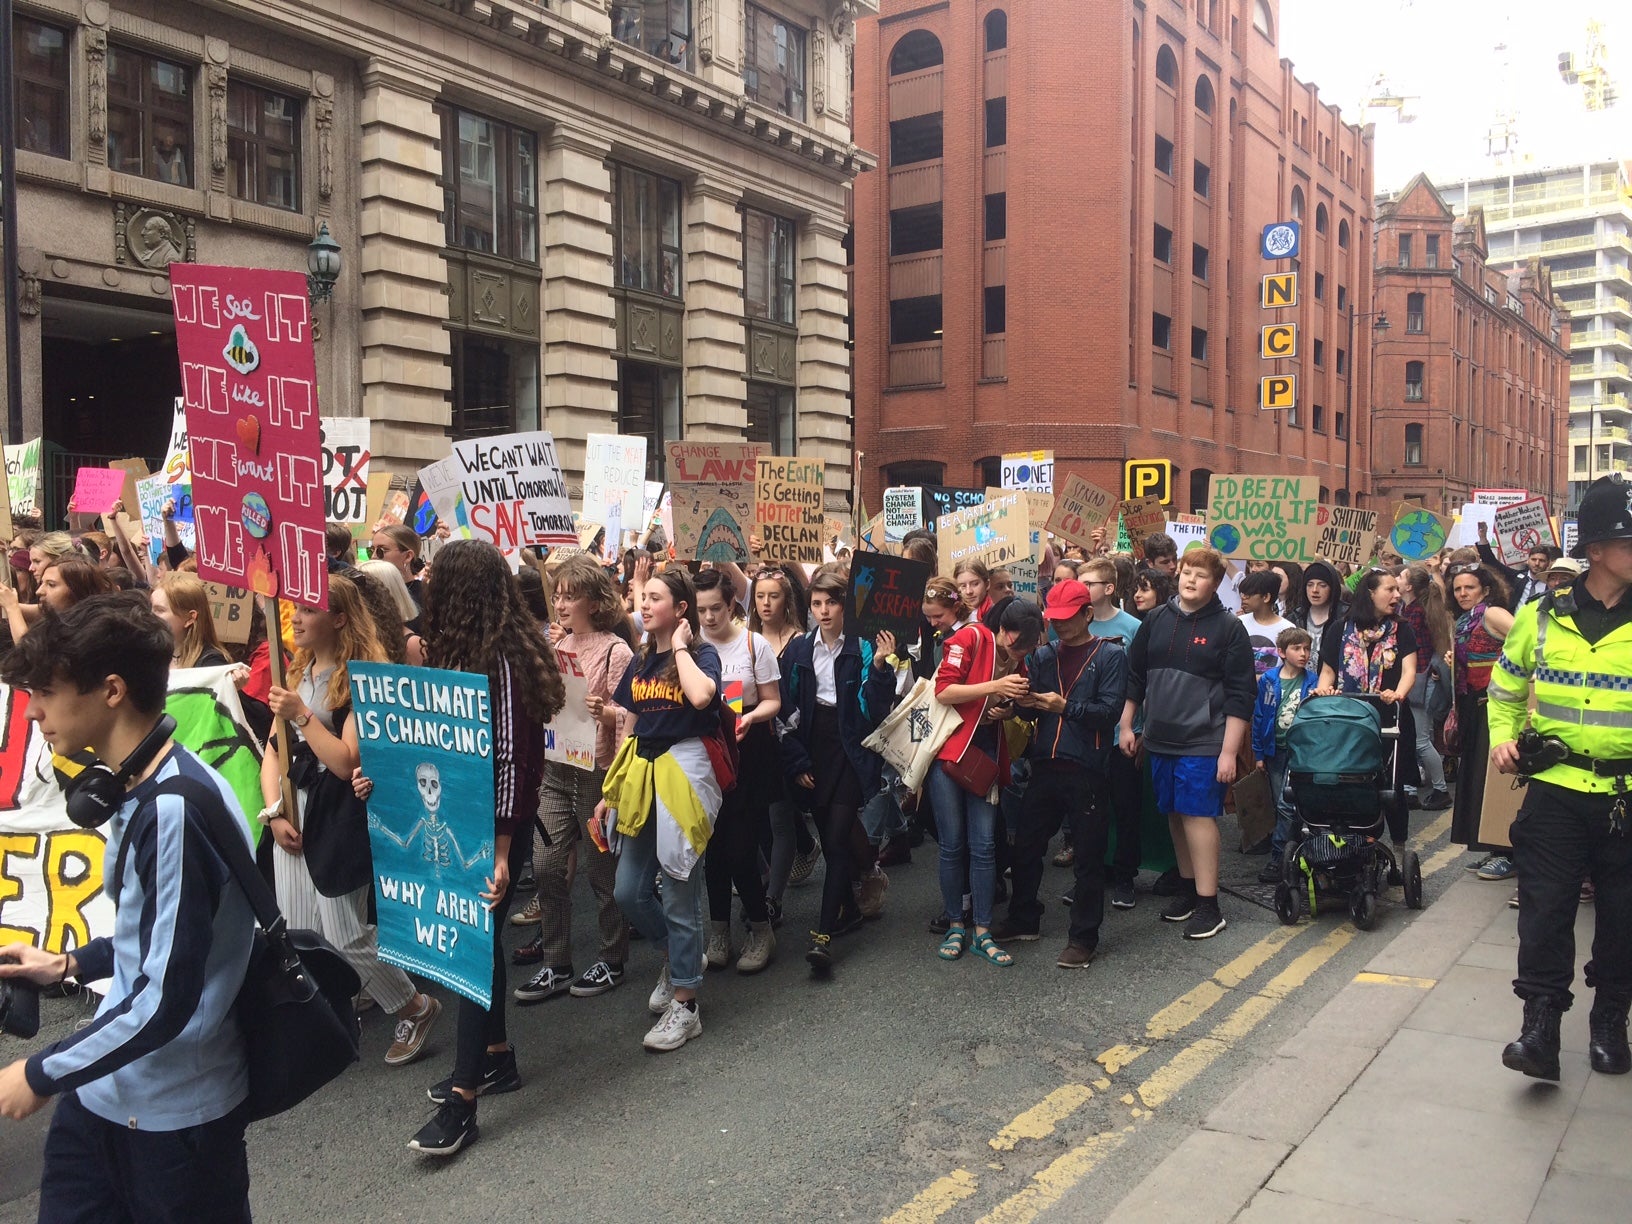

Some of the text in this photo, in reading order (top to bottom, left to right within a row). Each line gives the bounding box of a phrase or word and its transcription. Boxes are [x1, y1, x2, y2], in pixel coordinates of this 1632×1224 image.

[1267, 277, 1292, 304] N
[172, 284, 221, 329] WE
[264, 291, 308, 342] IT
[1267, 327, 1290, 353] C
[182, 362, 312, 430] WE like IT
[1268, 379, 1290, 405] P
[525, 441, 555, 467] WAIT
[607, 444, 622, 461] THE
[670, 445, 722, 458] CHANGE
[190, 436, 238, 487] WE
[276, 452, 318, 507] IT
[603, 465, 641, 487] REDUCE
[679, 458, 756, 482] LAWS
[758, 460, 824, 486] The Earth
[773, 482, 821, 509] Getting
[934, 492, 951, 502] NO
[1072, 481, 1106, 507] SPREAD
[1241, 478, 1267, 499] BE
[1270, 478, 1300, 499] IN
[940, 515, 952, 529] BE
[1000, 494, 1018, 508] THE
[1063, 497, 1083, 516] LOVE
[1210, 499, 1317, 525] SCHOOL IF
[1331, 507, 1377, 532] SHITTING
[470, 500, 535, 548] SAVE
[763, 524, 819, 543] DECLAN
[1173, 523, 1207, 535] THE TIM
[1240, 520, 1288, 538] WAS
[1322, 526, 1338, 542] ON
[195, 504, 326, 604] WE KILLED IT
[1249, 536, 1315, 562] COOL
[1316, 541, 1362, 562] FUTURE
[882, 568, 902, 590] I
[1017, 567, 1038, 578] THEY
[1012, 580, 1037, 593] TIME
[871, 590, 921, 618] SCREAM
[352, 674, 490, 723] THE CLIMATE
[356, 710, 491, 758] IS CHANGING
[379, 875, 426, 910] WHY
[414, 917, 459, 958] WE?
